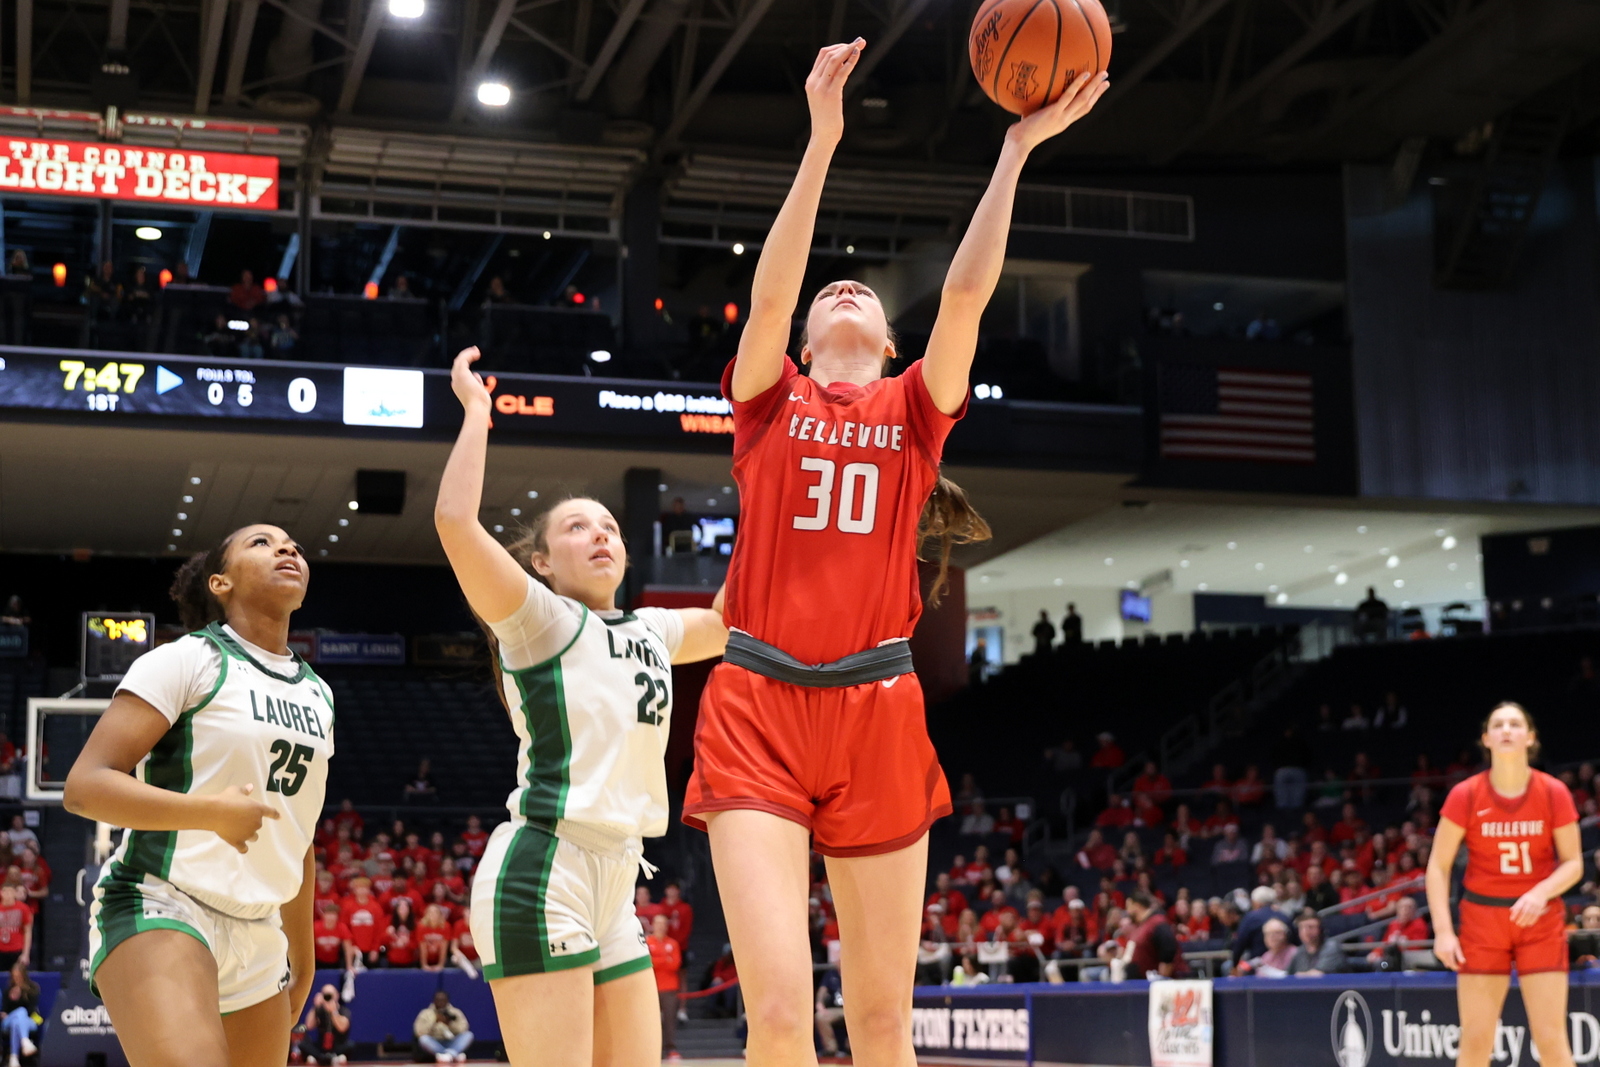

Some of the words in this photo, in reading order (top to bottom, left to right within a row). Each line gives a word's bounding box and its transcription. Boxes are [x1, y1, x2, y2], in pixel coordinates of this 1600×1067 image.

[9, 141, 69, 163] THE
[84, 147, 206, 172] CONNOR
[134, 167, 248, 204] DECK
[60, 360, 145, 394] 7:47
[208, 382, 223, 405] 0
[287, 377, 317, 413] 0
[87, 393, 119, 411] 1ST
[788, 413, 903, 451] BELLEVUE
[792, 456, 880, 535] 30
[320, 642, 358, 657] SAINT
[362, 642, 400, 657] LOUIS
[249, 689, 326, 740] LAUREL
[634, 671, 669, 727] 22
[266, 738, 315, 797] 25
[1481, 820, 1544, 837] BELLEVUE
[1498, 841, 1533, 874] 21
[951, 1008, 1030, 1051] FLYERS
